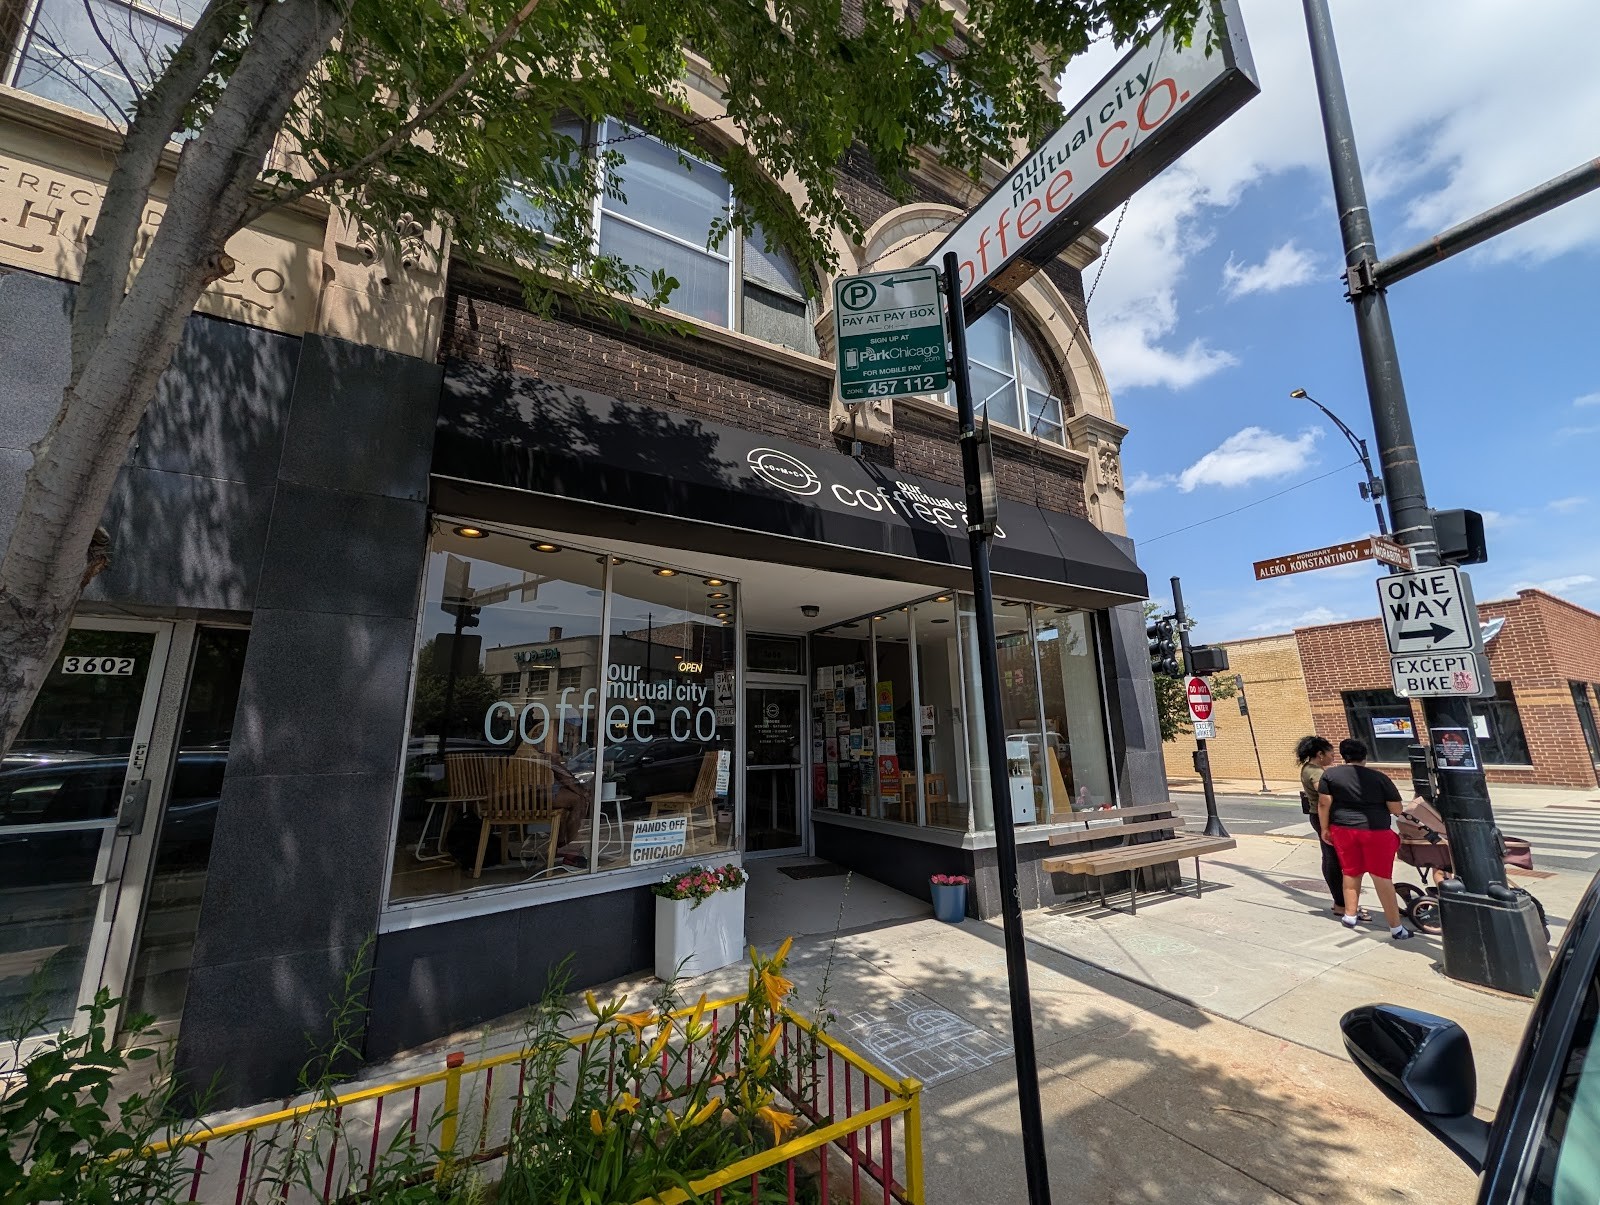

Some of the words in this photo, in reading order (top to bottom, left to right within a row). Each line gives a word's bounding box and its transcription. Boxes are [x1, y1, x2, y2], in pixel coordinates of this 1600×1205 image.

[1012, 116, 1093, 209] mutual
[1099, 61, 1154, 125] city
[1011, 144, 1050, 192] our
[955, 169, 1074, 298] offee
[851, 286, 868, 305] P
[842, 316, 864, 327] PAY
[866, 315, 881, 324] AT
[884, 312, 906, 321] PAY
[909, 307, 936, 318] BOX
[870, 337, 888, 345] SIGN
[860, 345, 940, 363] ParkChicago
[863, 369, 878, 377] FOR
[879, 366, 907, 375] MOBILE
[867, 380, 898, 395] 457
[904, 376, 935, 391] 112
[896, 481, 921, 494] our
[831, 484, 957, 529] coffee
[900, 490, 956, 511] mutual
[955, 501, 967, 512] ci
[1260, 564, 1286, 577] ALEKO
[1290, 550, 1359, 571] KONSTANTINOV
[1296, 548, 1331, 560] HONORARY
[1388, 575, 1449, 600] ONE
[1389, 597, 1453, 621] WAY
[65, 657, 133, 674] 3602
[608, 663, 641, 682] our
[678, 662, 703, 673] OPEN
[1396, 657, 1467, 674] EXCEPT
[607, 679, 672, 700] mutual
[676, 680, 708, 706] city
[1407, 676, 1452, 691] BIKE
[484, 687, 655, 745] coffee
[1194, 704, 1209, 712] ENTER
[134, 744, 147, 766] PULL
[635, 820, 667, 834] HANDS
[669, 819, 685, 831] OFF
[633, 844, 683, 862] CHICAGO
